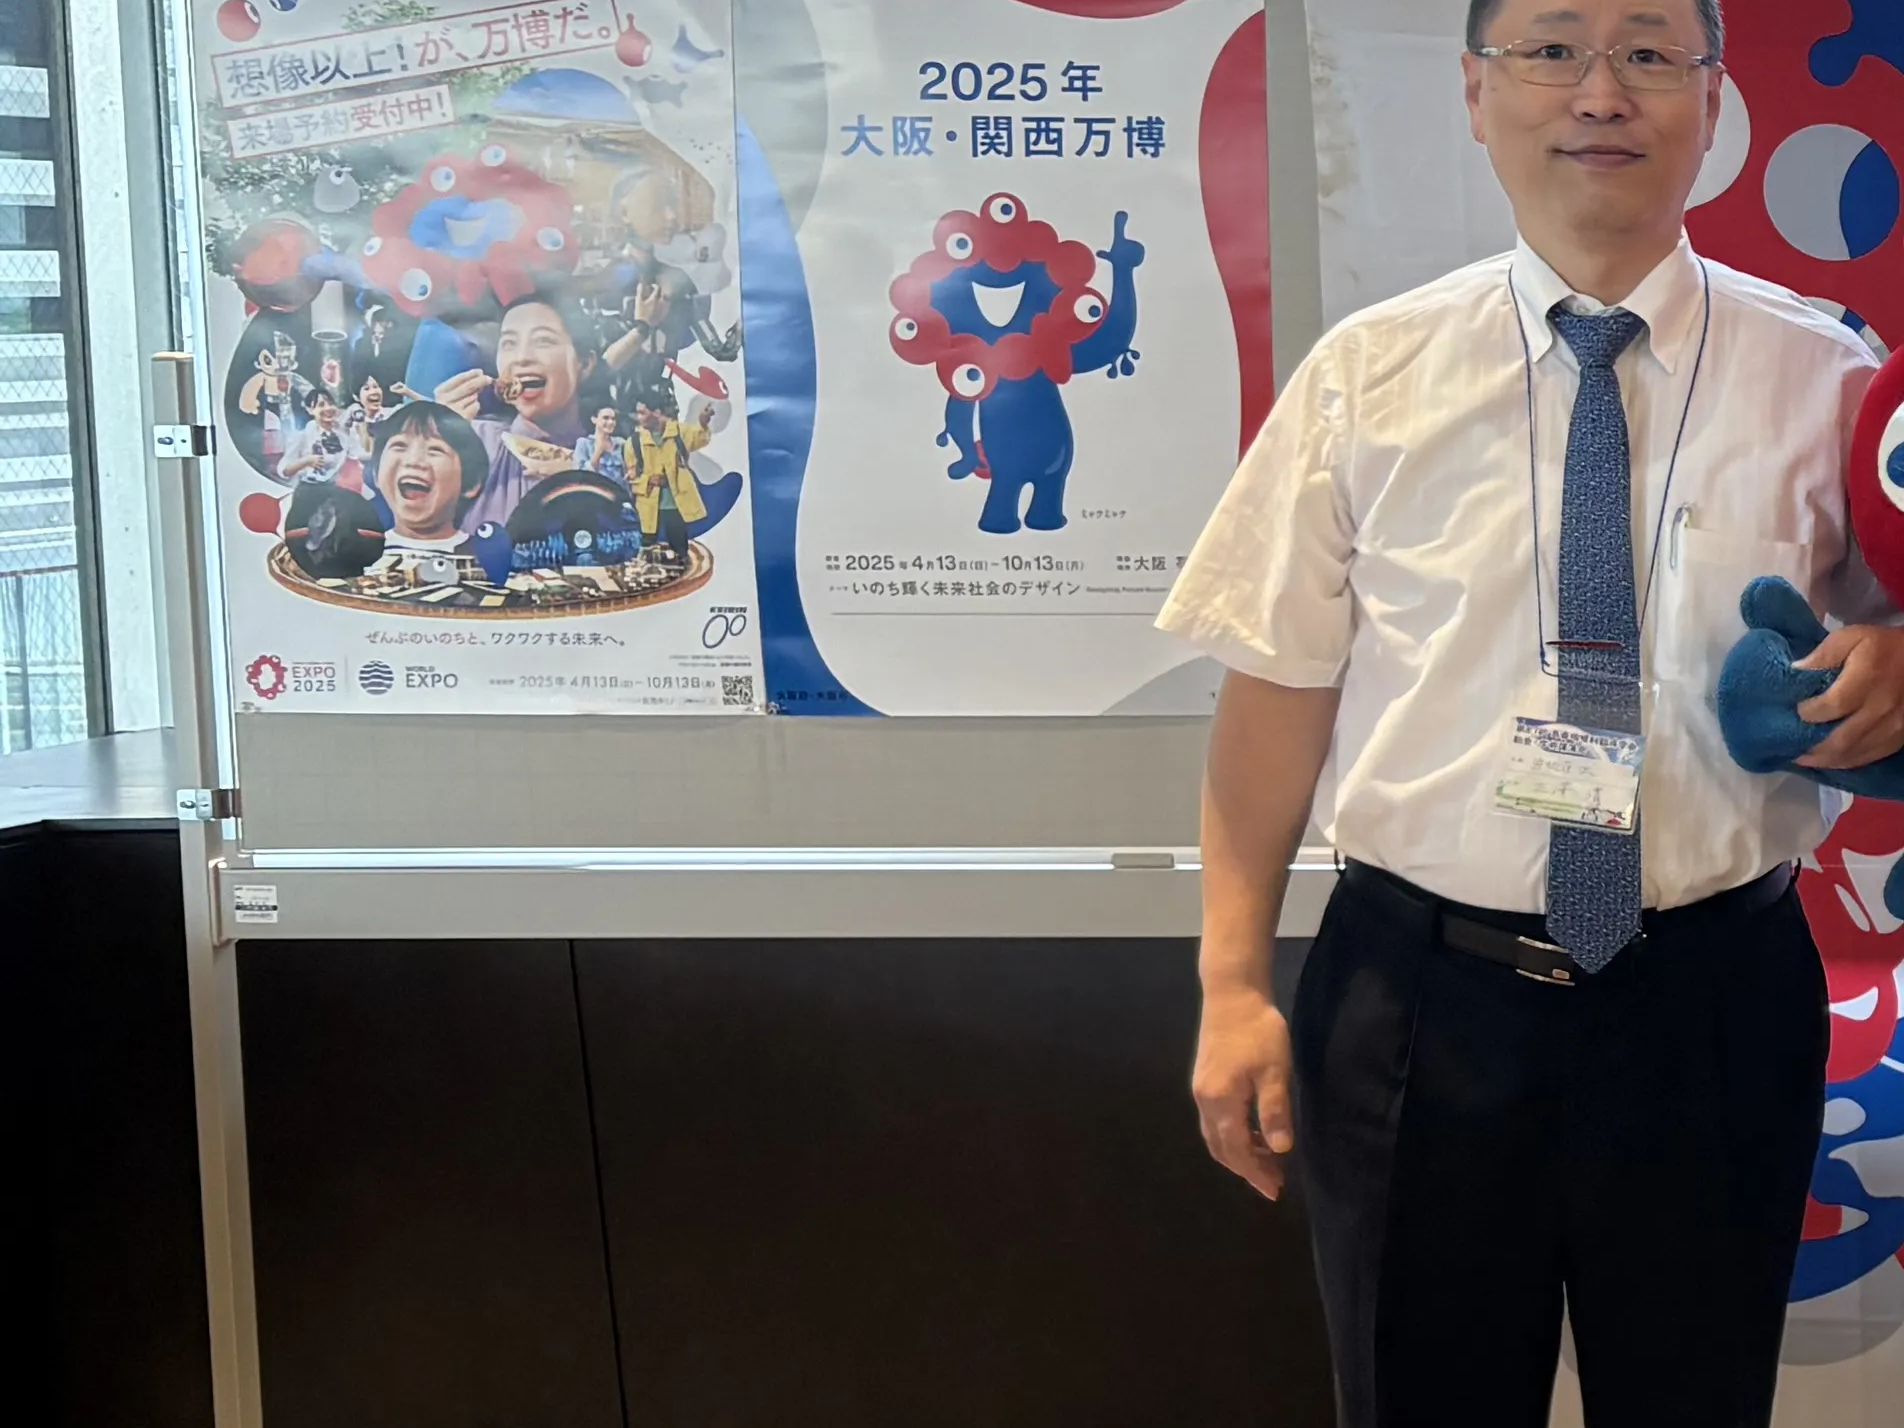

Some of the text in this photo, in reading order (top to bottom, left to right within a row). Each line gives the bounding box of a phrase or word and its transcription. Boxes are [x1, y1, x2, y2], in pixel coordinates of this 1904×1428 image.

[918, 60, 1103, 102] 2025年
[840, 114, 1166, 158] 大阪・関西万博
[852, 580, 1081, 596] いのち輝く未来社会のデザイン
[292, 666, 336, 679] EXPO
[405, 665, 436, 673] WORLD
[293, 679, 337, 693] 2025
[405, 673, 459, 689] EXPO
